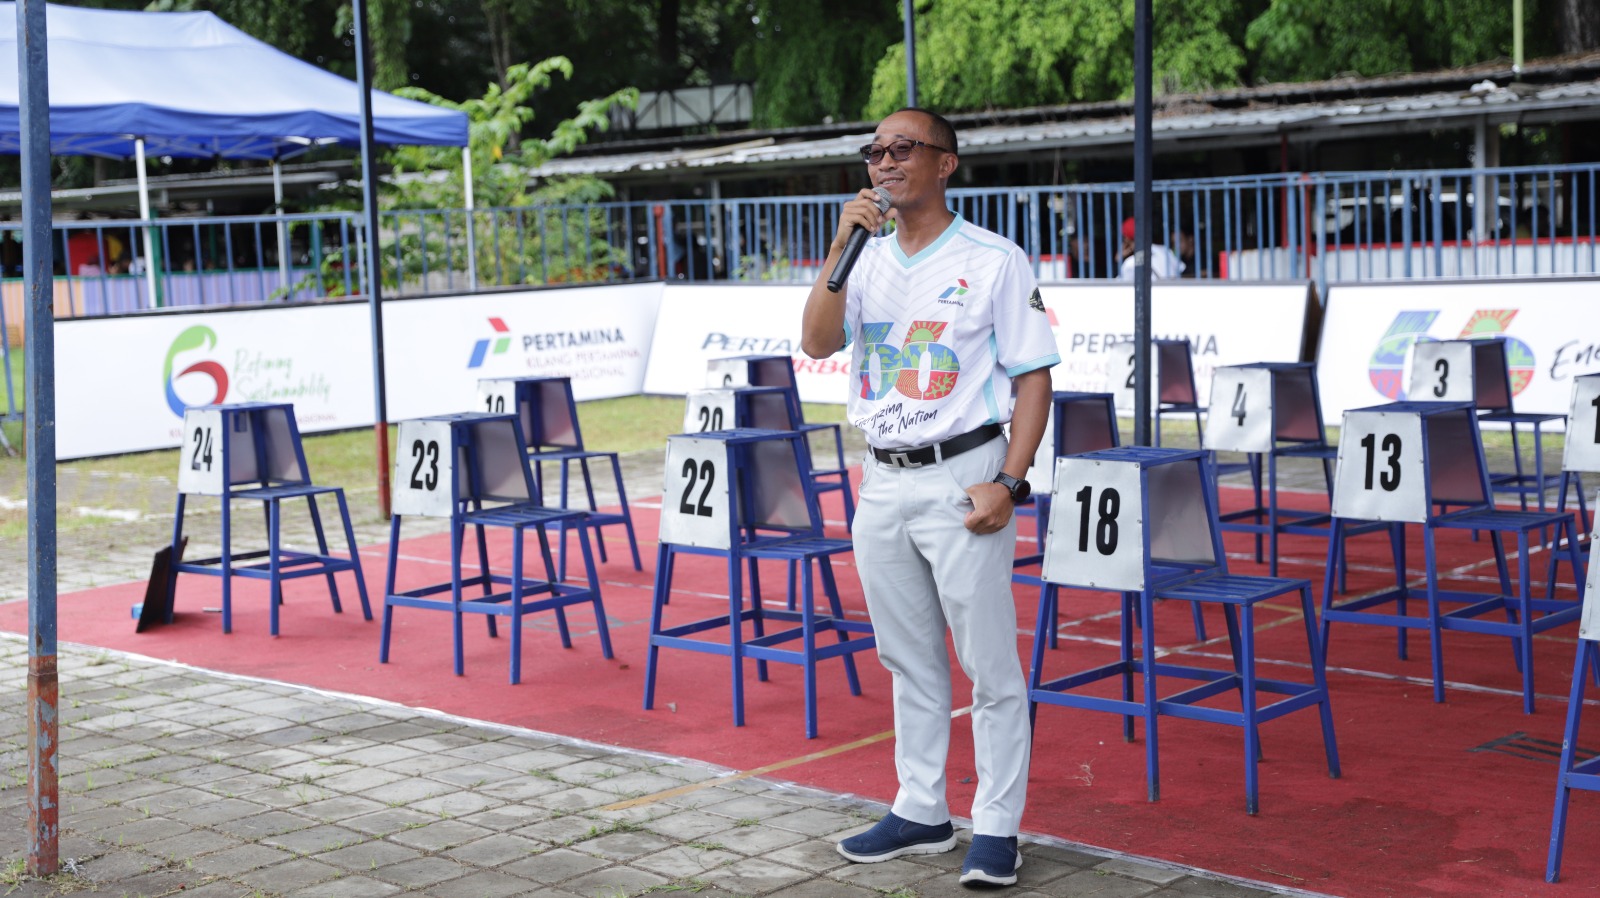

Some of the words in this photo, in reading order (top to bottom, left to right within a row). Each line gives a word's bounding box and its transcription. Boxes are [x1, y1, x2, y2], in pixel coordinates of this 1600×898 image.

[937, 299, 964, 308] PERTAMINA
[522, 328, 624, 351] PERTAMINA
[701, 332, 801, 353] PERTA
[1433, 358, 1449, 398] 3
[878, 420, 894, 438] the
[898, 409, 938, 434] Nation
[1231, 383, 1247, 427] 4
[191, 426, 213, 472] 24
[410, 439, 439, 491] 23
[1361, 433, 1402, 491] 13
[679, 457, 715, 517] 22
[1076, 485, 1120, 556] 18
